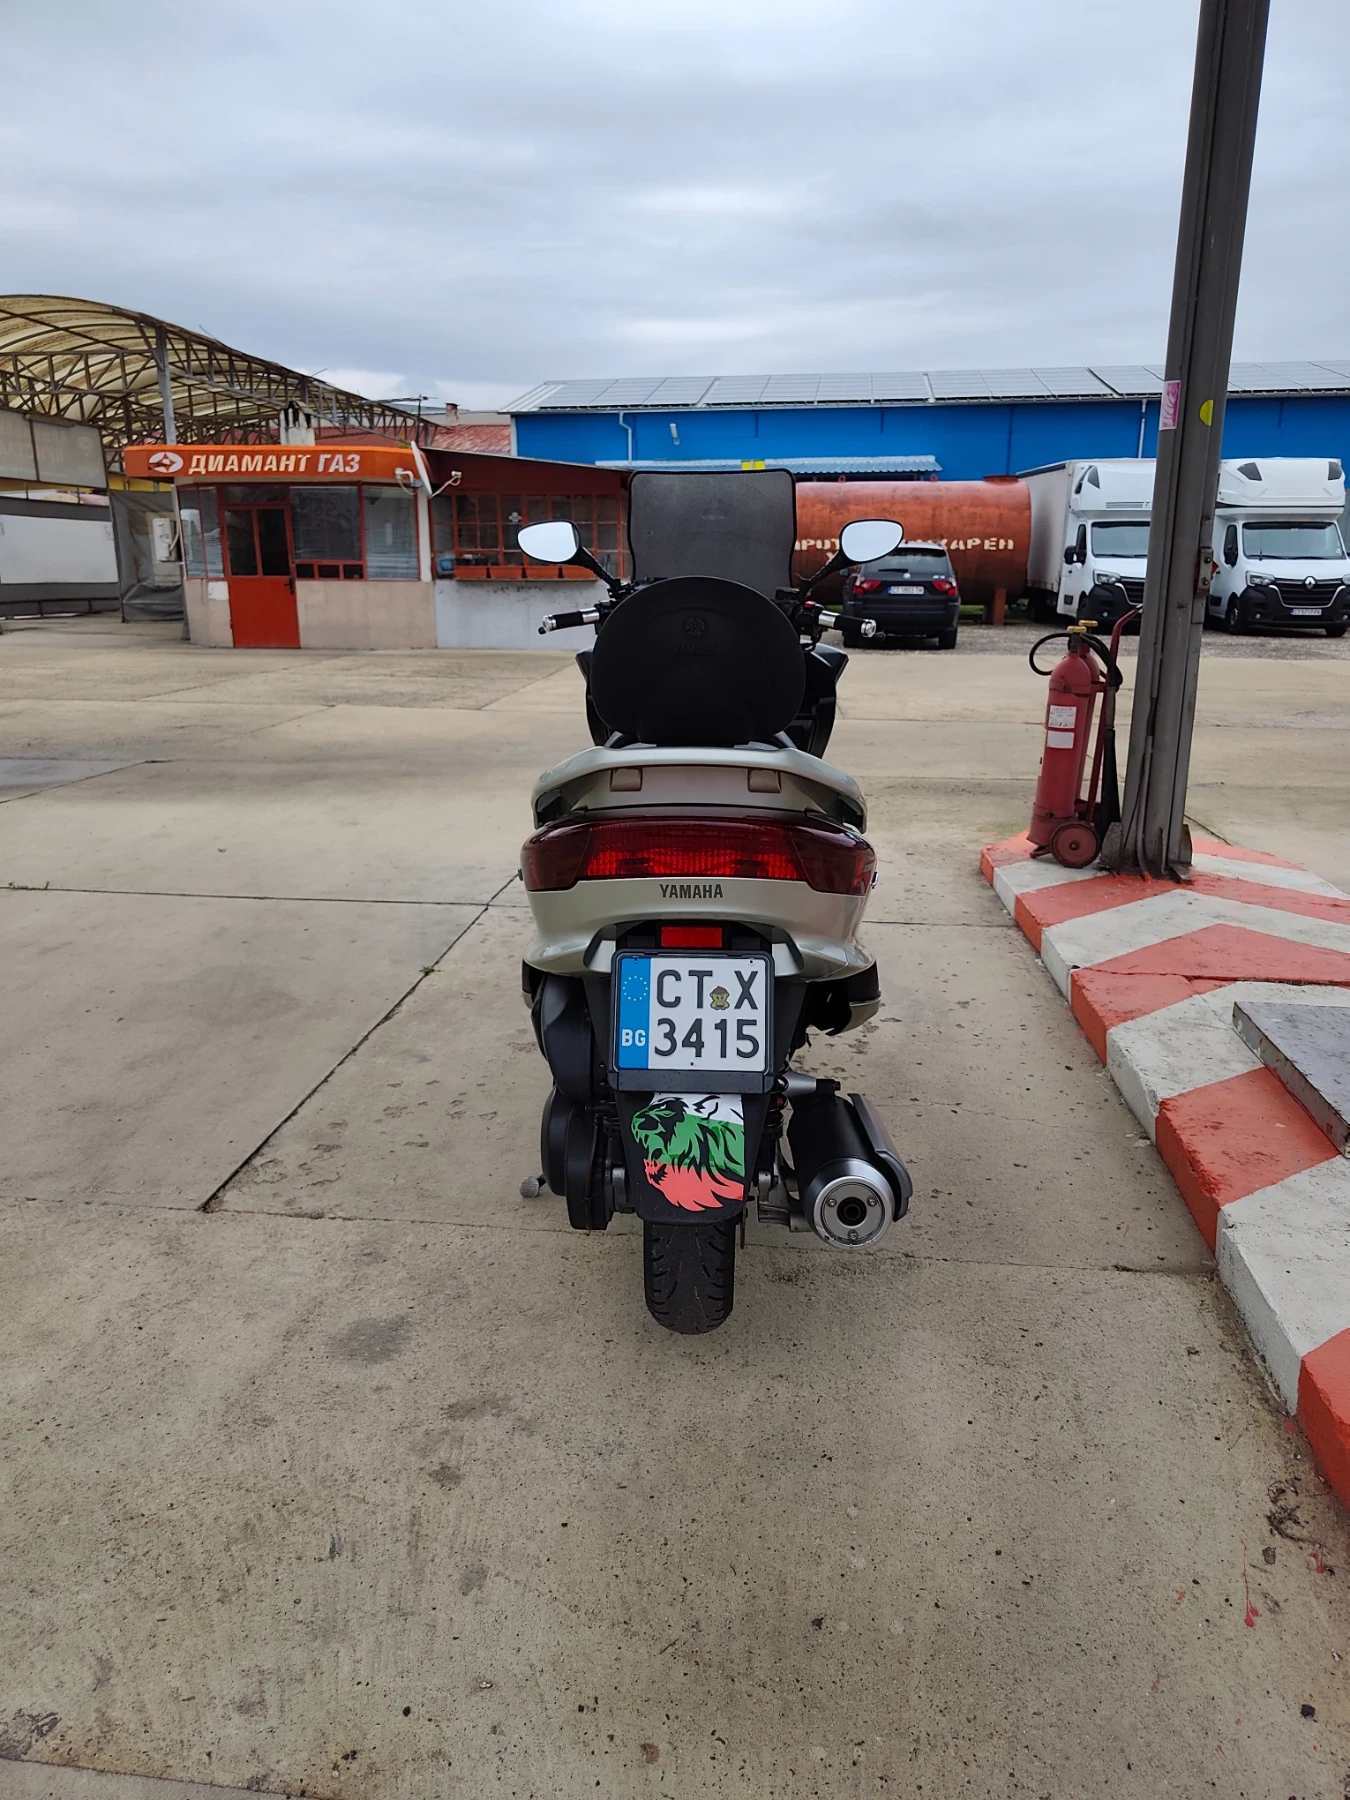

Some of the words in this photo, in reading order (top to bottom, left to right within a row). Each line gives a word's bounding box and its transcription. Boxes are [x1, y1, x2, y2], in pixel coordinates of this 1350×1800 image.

[189, 454, 311, 475] ДИАМАНТ
[317, 453, 360, 473] ГАЗ
[659, 884, 724, 899] YAMAHA
[656, 969, 713, 1009] CT
[734, 970, 759, 1010] X
[621, 1029, 646, 1047] BG
[654, 1017, 760, 1059] 3415
